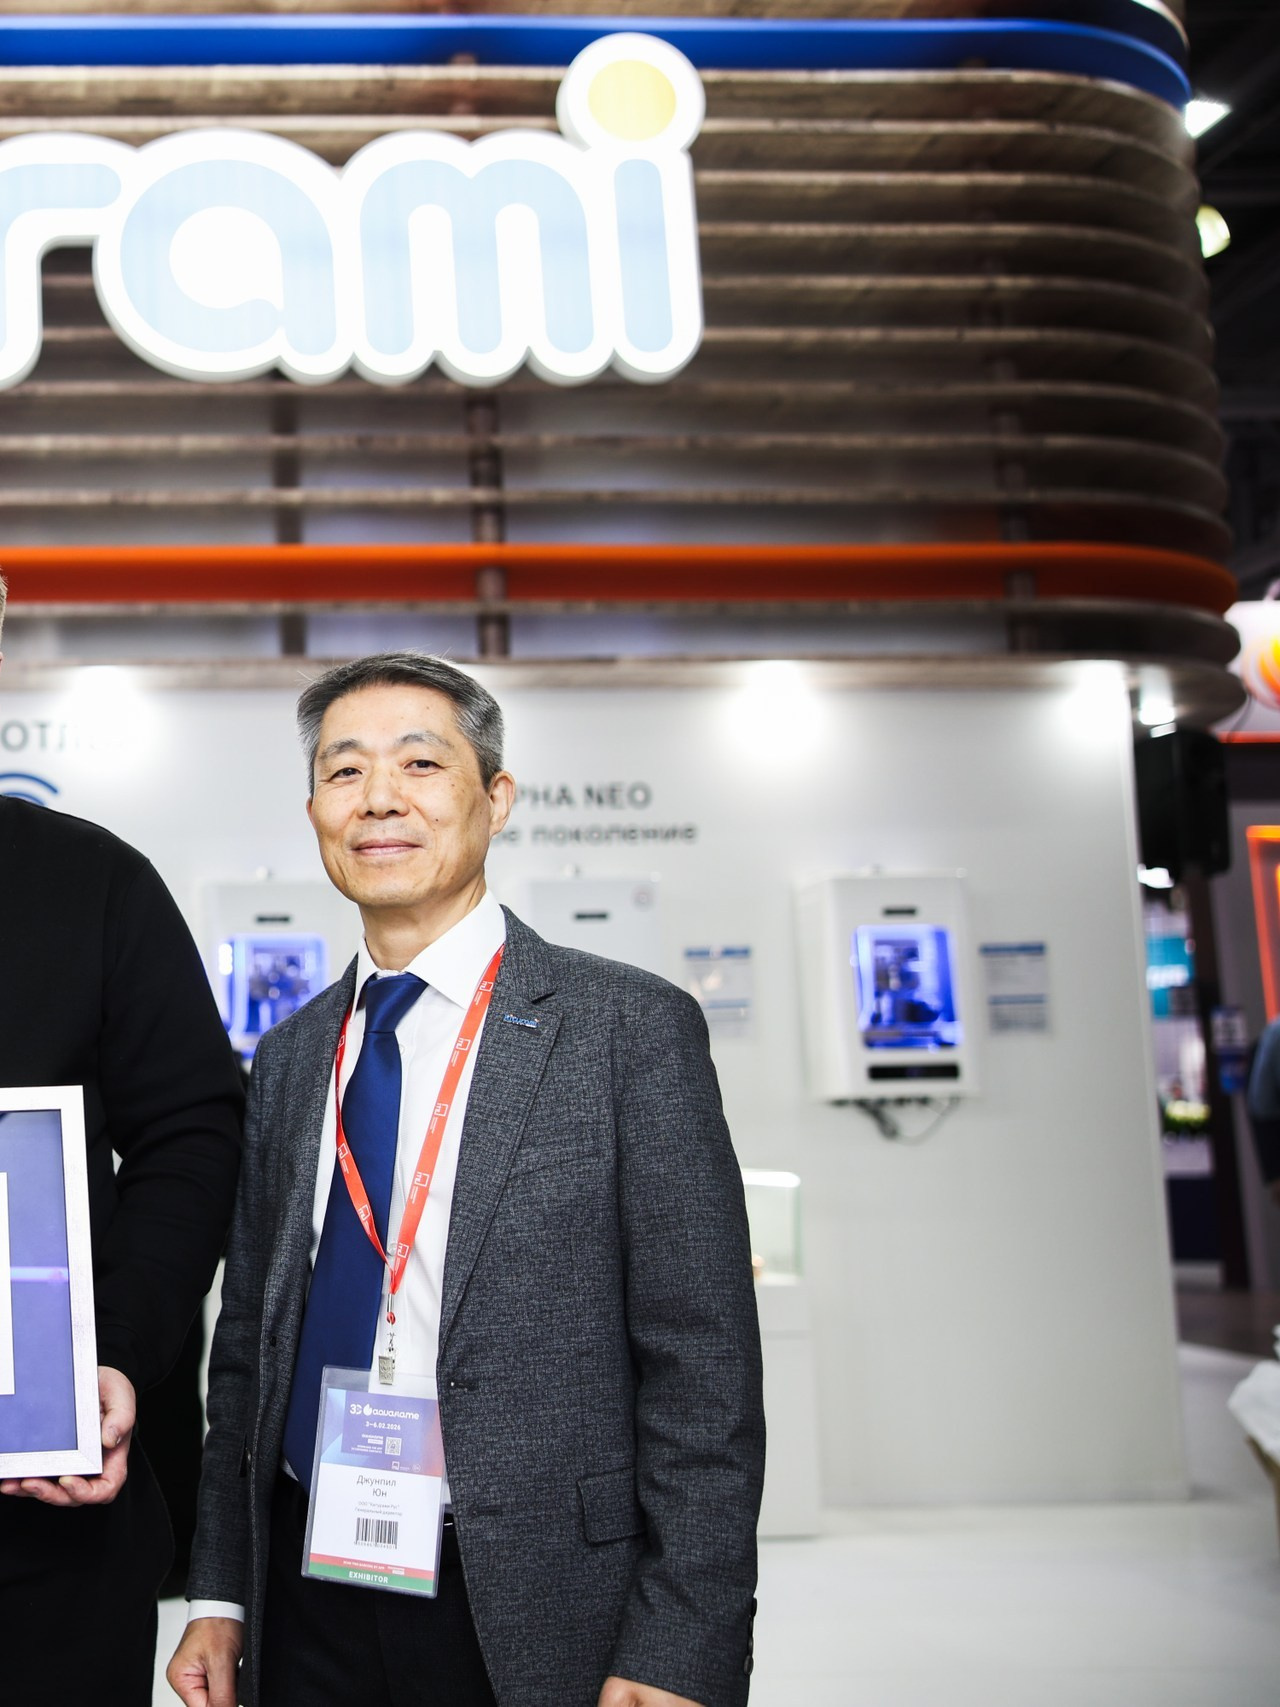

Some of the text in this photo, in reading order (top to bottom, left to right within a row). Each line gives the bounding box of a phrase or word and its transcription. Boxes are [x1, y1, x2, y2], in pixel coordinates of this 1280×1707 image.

[582, 782, 653, 810] NEO
[531, 823, 698, 847] поколение
[356, 1474, 397, 1487] Джунпил
[372, 1487, 388, 1498] Юн
[348, 1570, 389, 1584] EXHIBITOR
